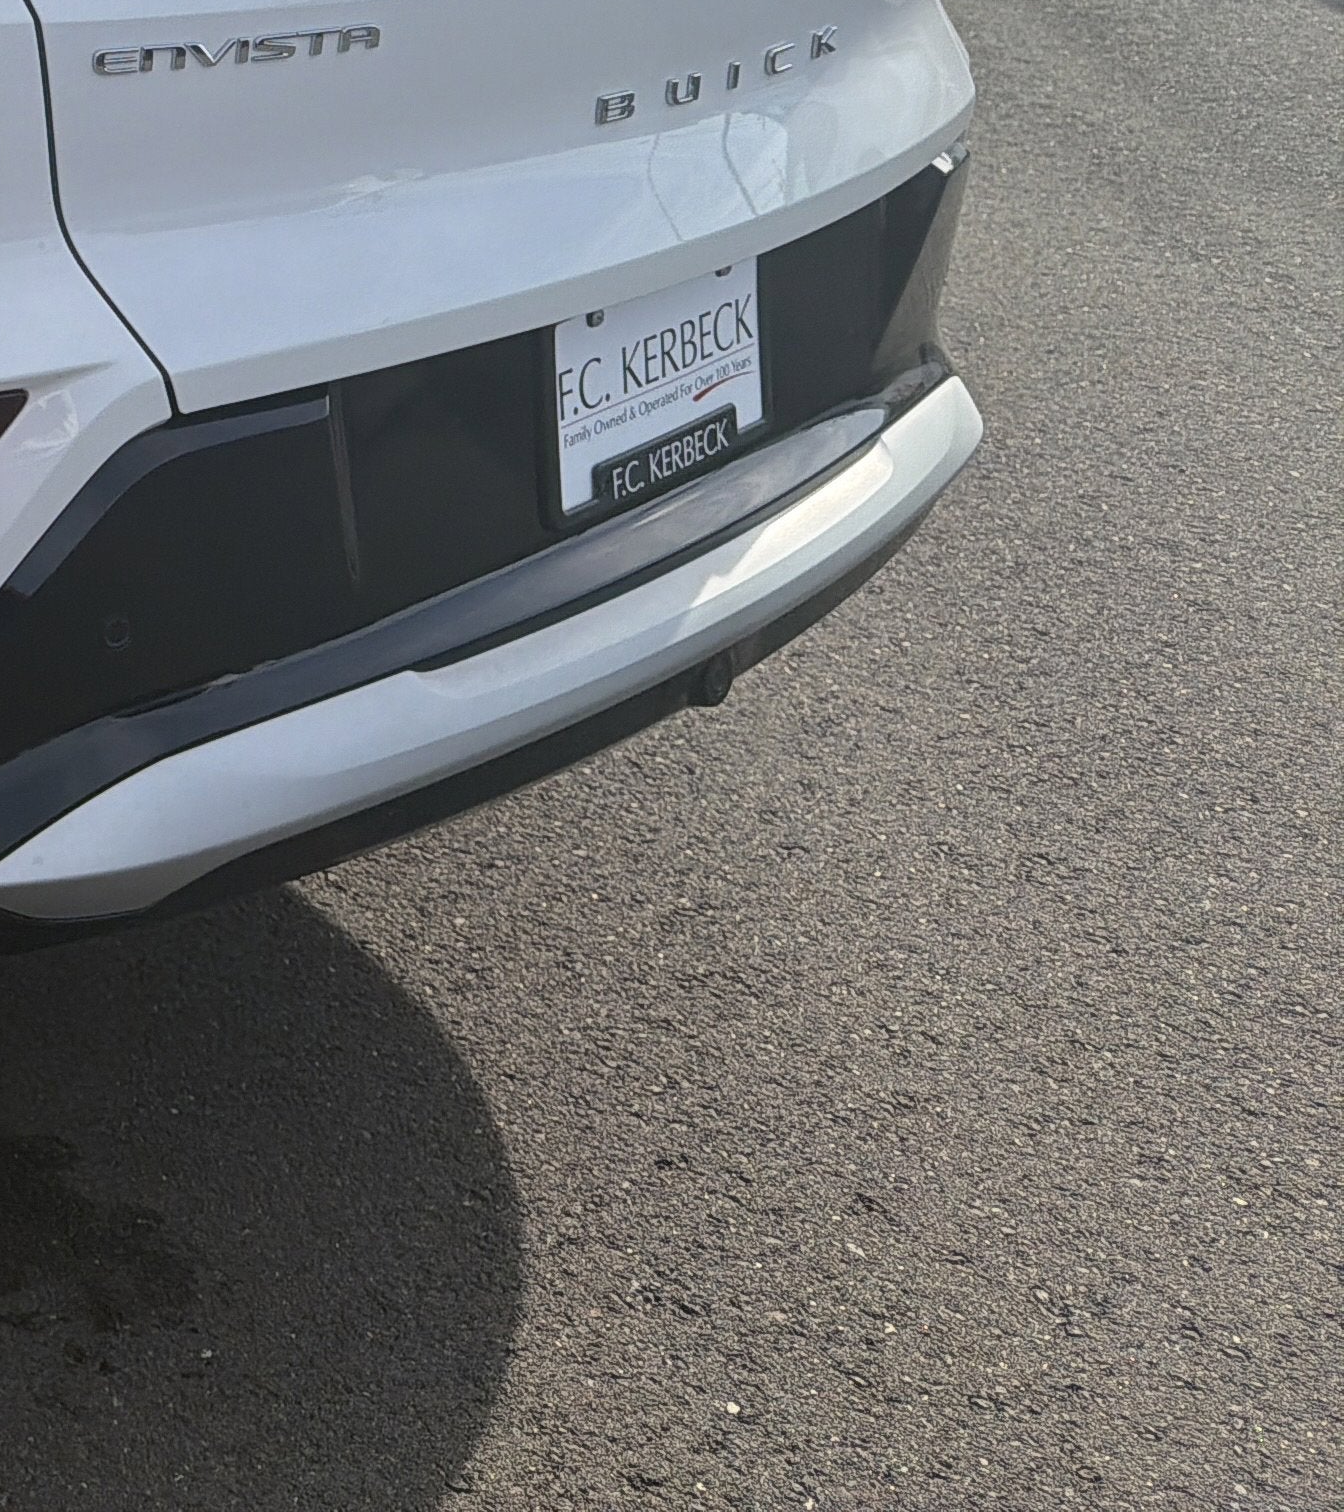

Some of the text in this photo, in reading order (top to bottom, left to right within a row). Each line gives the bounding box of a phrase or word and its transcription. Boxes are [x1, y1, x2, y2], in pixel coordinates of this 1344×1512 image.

[92, 23, 381, 75] ENVISTA
[594, 25, 838, 125] BUICK
[559, 293, 753, 421] F.C. KERBECK
[564, 356, 752, 448] Family Owned & Operated For Over 100 Years
[612, 419, 729, 500] F.C. KERBECK
